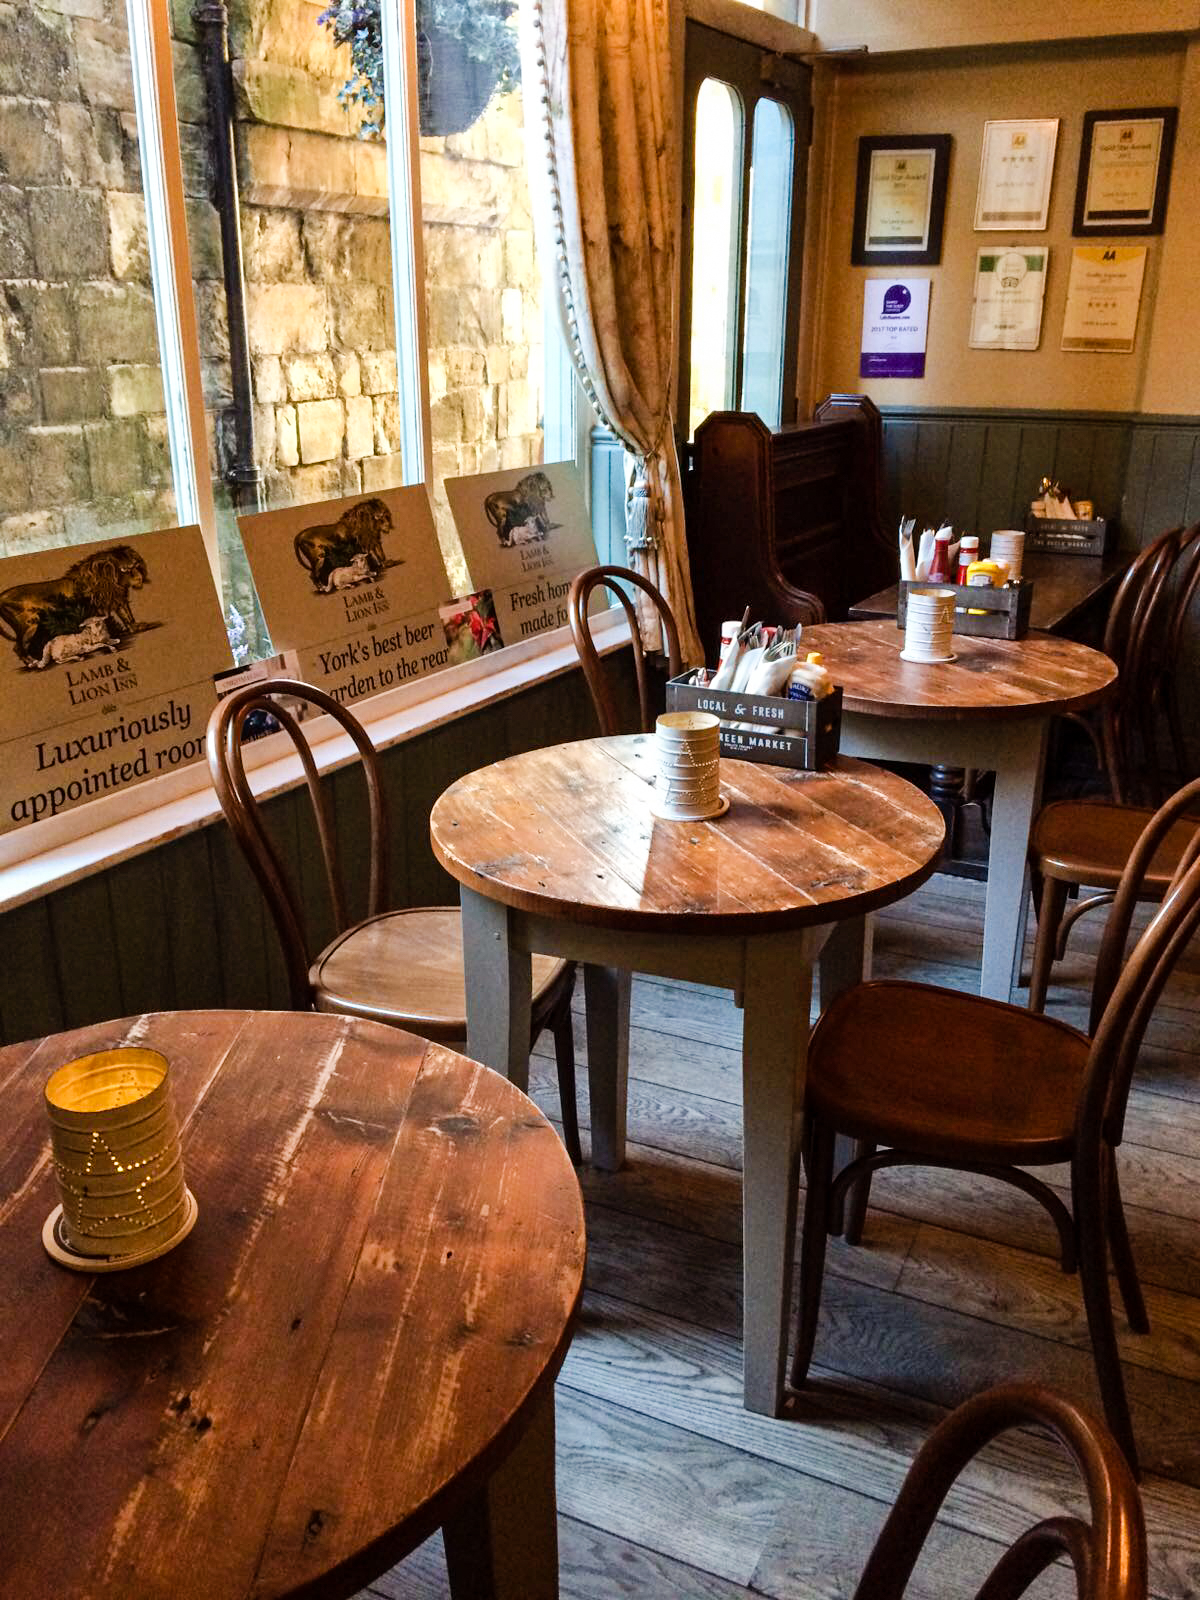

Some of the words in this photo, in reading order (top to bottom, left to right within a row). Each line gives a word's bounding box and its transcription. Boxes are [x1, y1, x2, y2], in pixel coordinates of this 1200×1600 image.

[1102, 250, 1116, 261] AA
[343, 591, 374, 608] LAMB
[375, 586, 385, 600] &
[510, 584, 545, 611] Fresh
[547, 581, 572, 600] hom
[520, 609, 555, 635] made
[319, 640, 370, 675] York's
[371, 631, 402, 656] best
[404, 623, 434, 646] beer
[66, 664, 115, 687] LAMB
[116, 657, 132, 673] &
[329, 674, 376, 702] arden
[379, 668, 394, 687] to
[397, 657, 419, 680] the
[421, 647, 450, 671] rear
[68, 684, 110, 706] LION
[697, 698, 727, 712] LOCAL
[734, 703, 747, 715] &
[752, 705, 784, 719] FRESH
[35, 700, 191, 771] Luxuriously
[719, 732, 743, 745] REEN
[748, 736, 792, 751] MARKET
[11, 748, 150, 822] appointed
